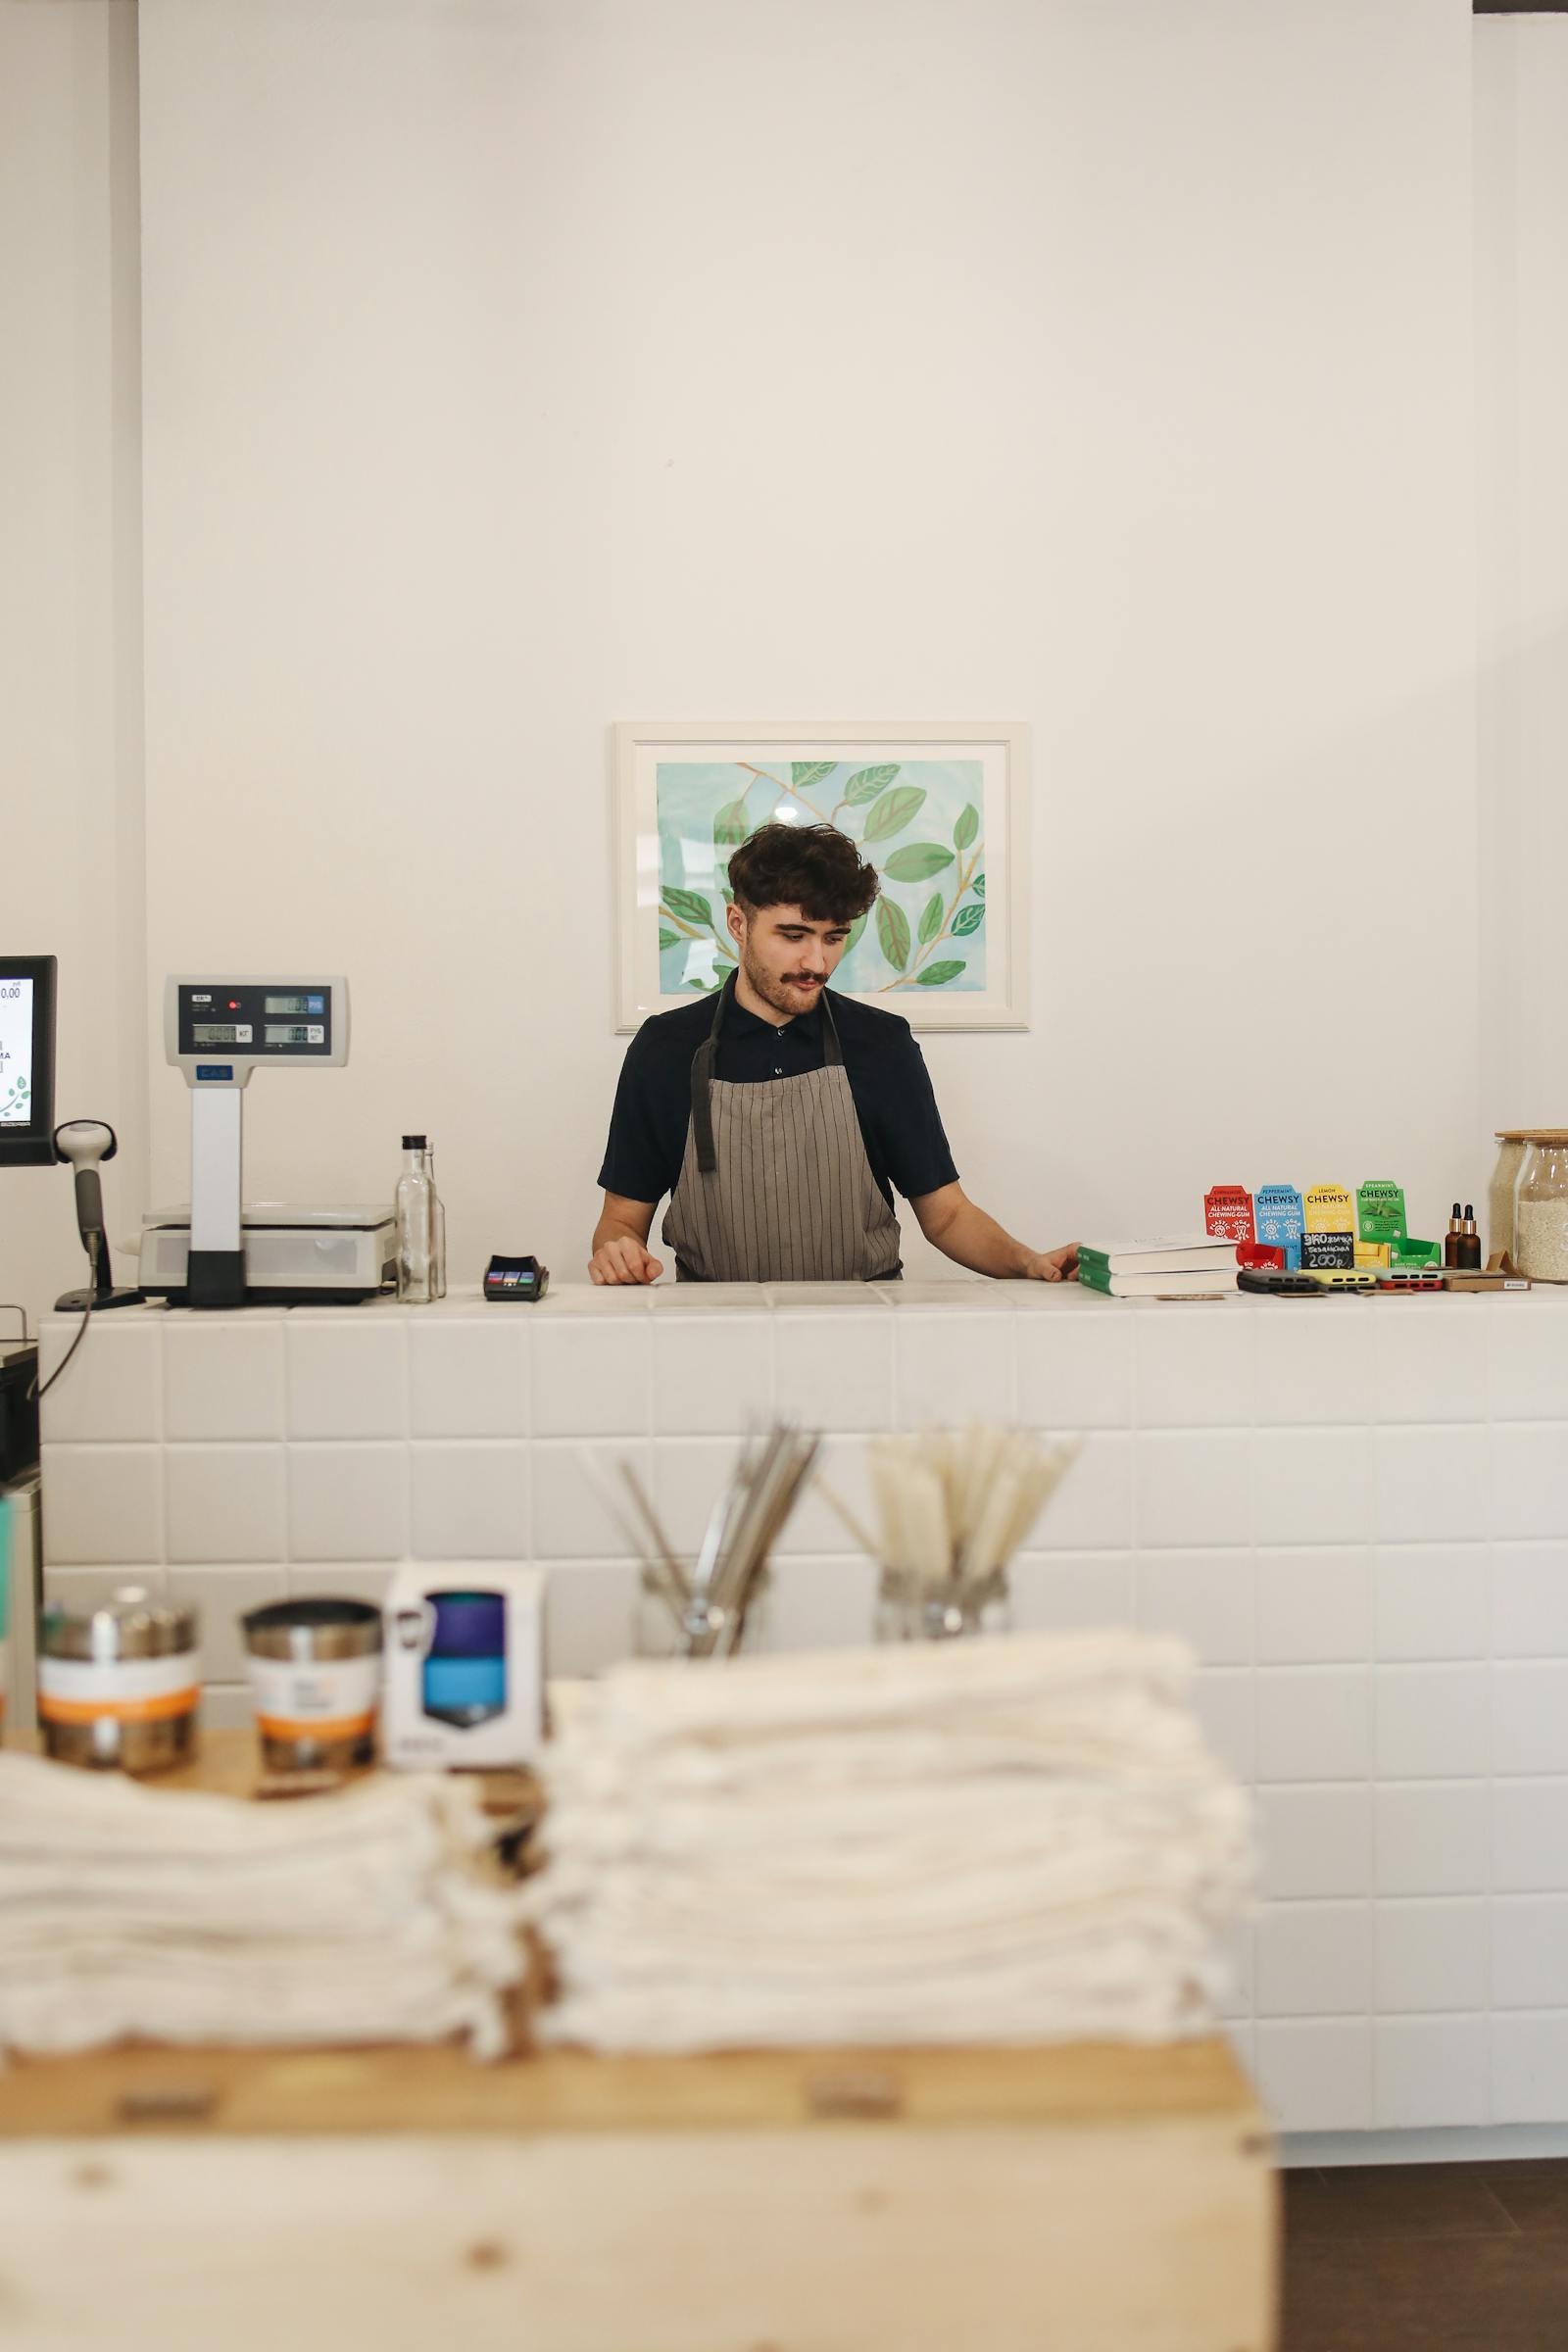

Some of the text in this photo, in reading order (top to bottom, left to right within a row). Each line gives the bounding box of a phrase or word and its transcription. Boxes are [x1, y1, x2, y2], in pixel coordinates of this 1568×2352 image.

[1258, 1196, 1299, 1204] CHEWSY
[1307, 1195, 1349, 1203] CHEWSY
[1210, 1220, 1230, 1230] PLASTIC
[1232, 1220, 1250, 1228] SUGAR
[1261, 1219, 1281, 1229] PLASTIC
[1260, 1262, 1278, 1270] SUGAR
